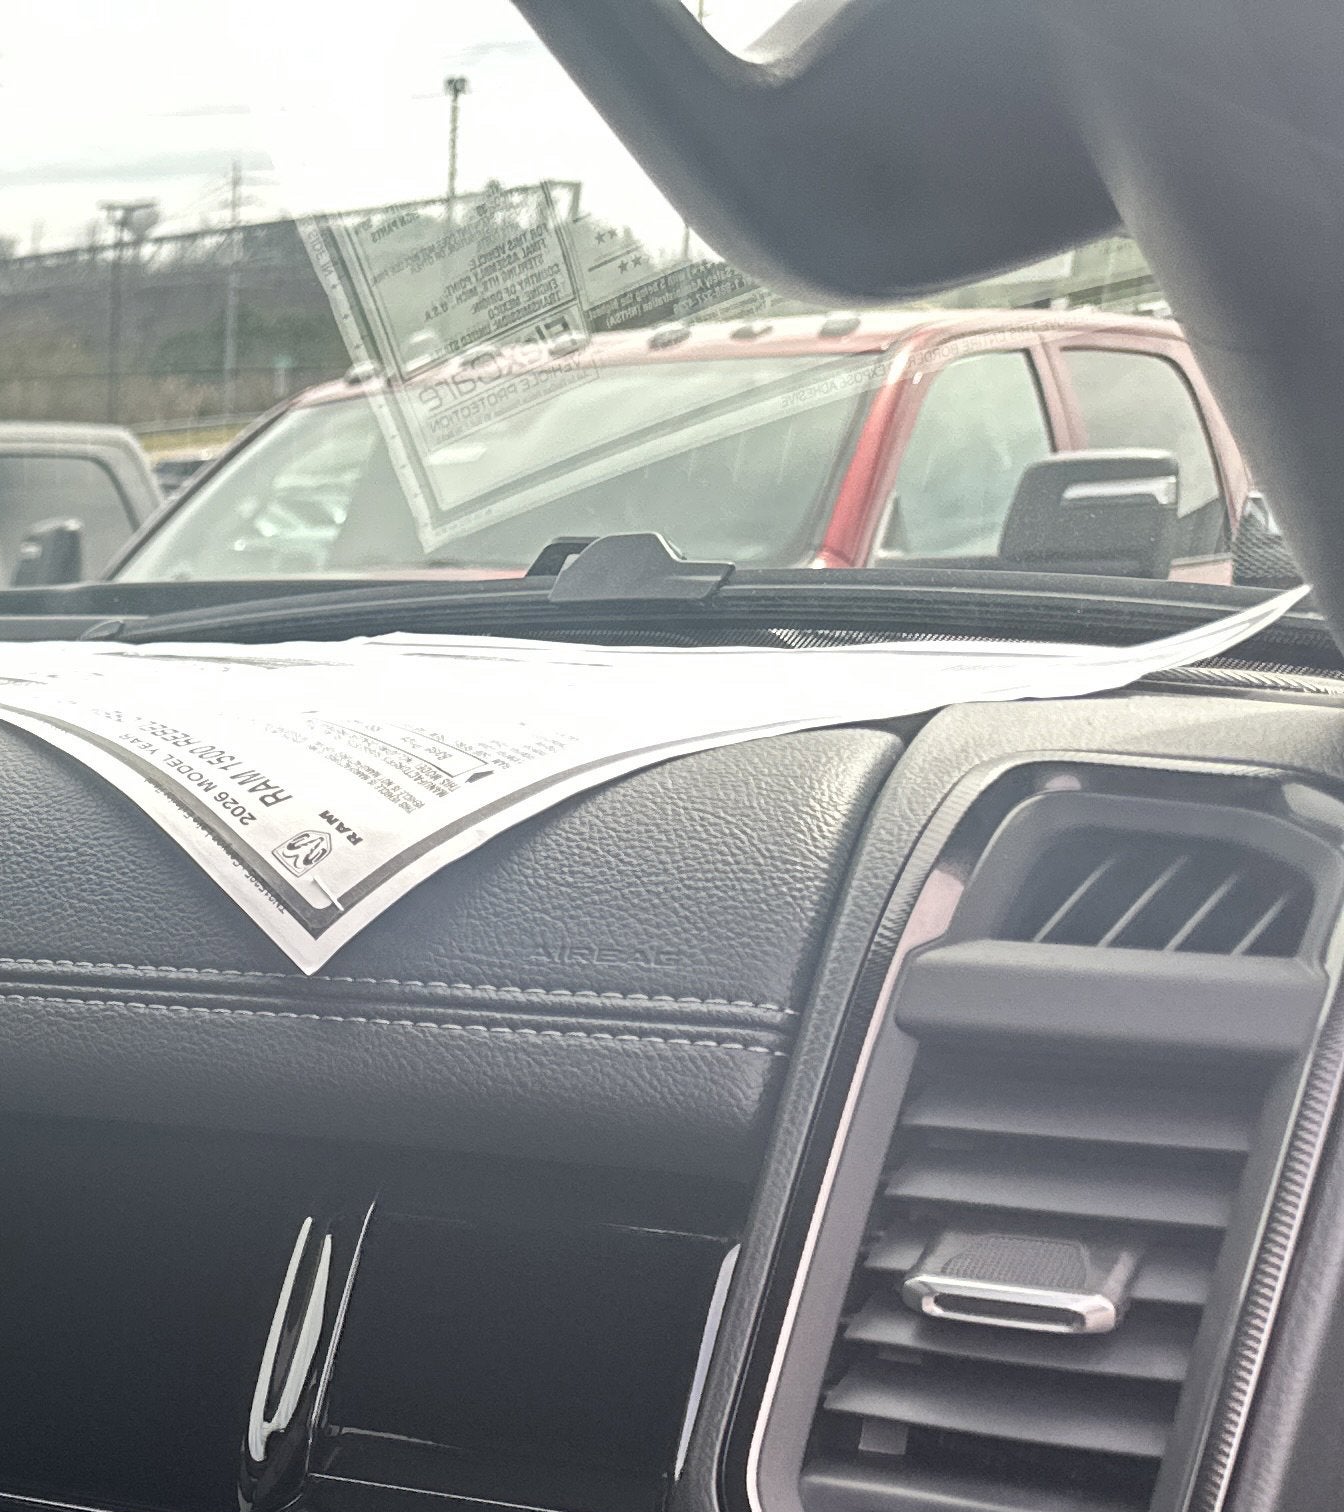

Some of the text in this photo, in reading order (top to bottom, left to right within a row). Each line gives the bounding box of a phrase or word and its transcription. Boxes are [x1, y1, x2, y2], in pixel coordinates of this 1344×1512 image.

[158, 752, 216, 792] MODEL
[188, 741, 242, 771] 1500
[229, 768, 293, 808] RAM
[213, 790, 257, 826] 2026
[317, 809, 363, 847] RAM
